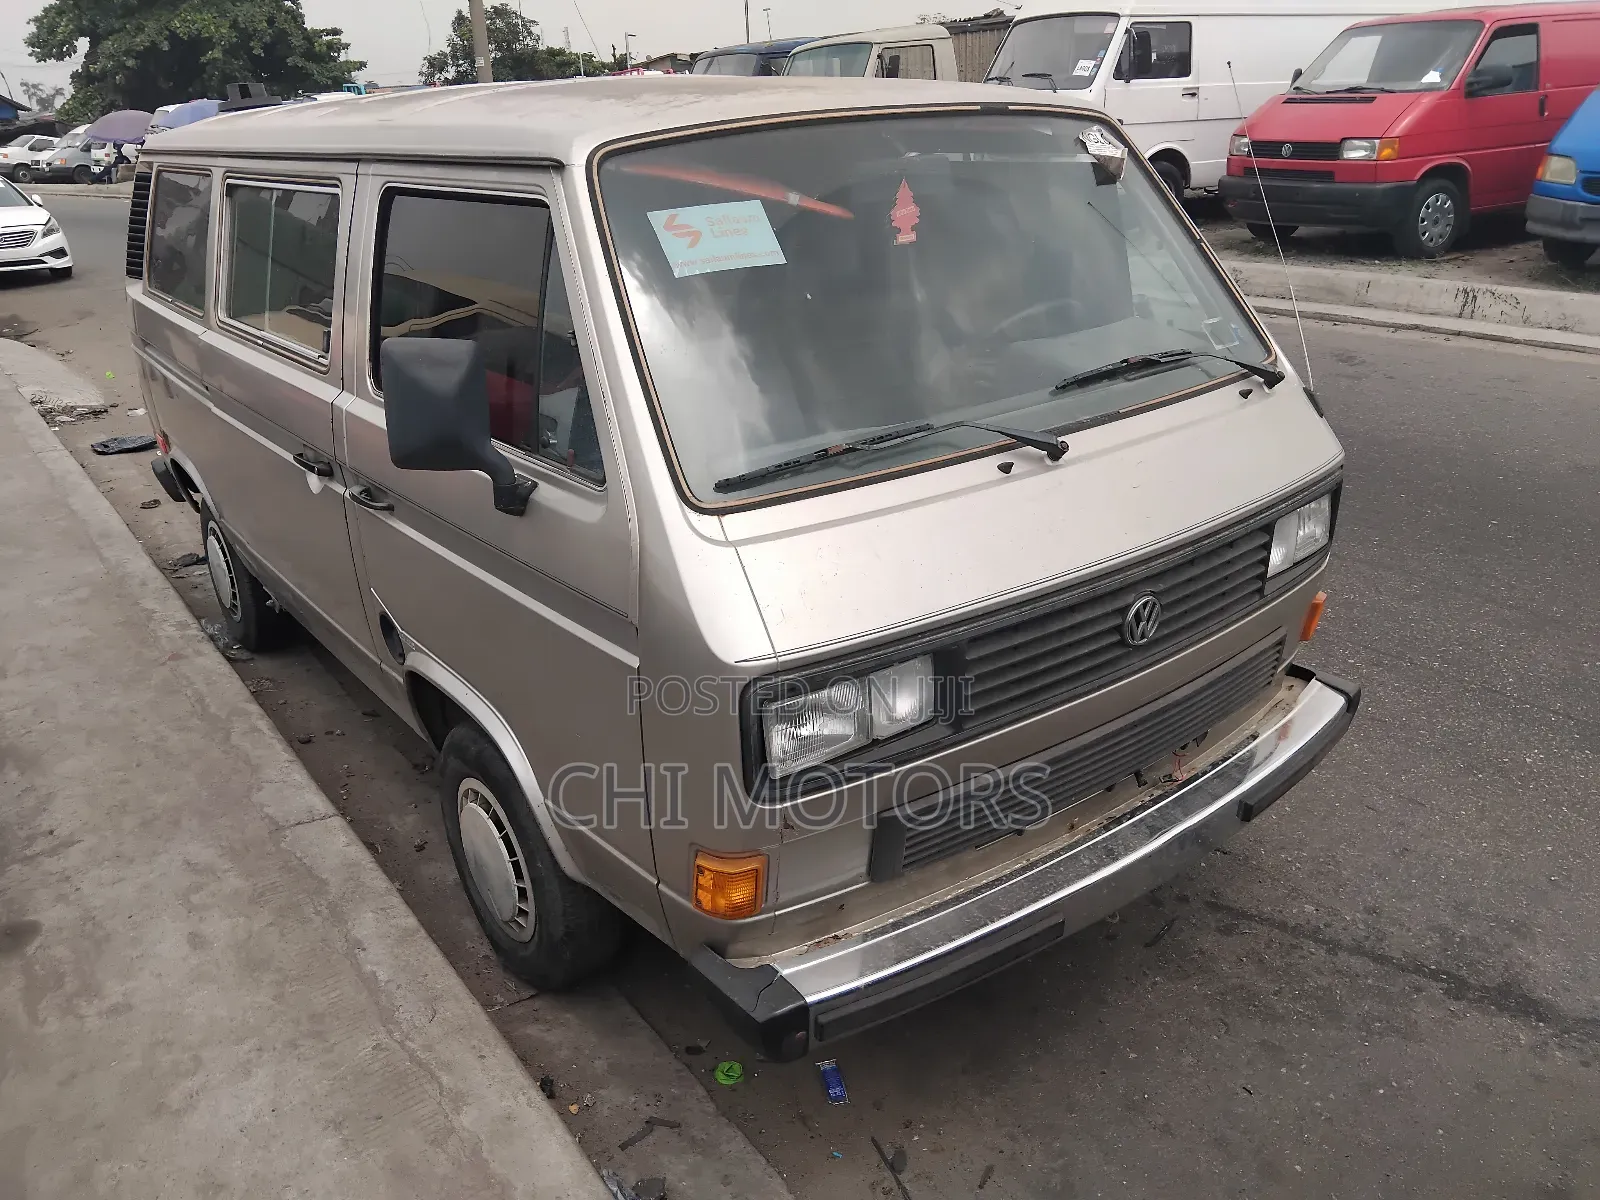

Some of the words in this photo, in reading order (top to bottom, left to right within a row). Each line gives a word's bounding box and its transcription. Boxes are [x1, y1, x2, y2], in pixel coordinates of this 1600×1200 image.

[704, 213, 761, 227] Sallaum
[709, 226, 749, 239] Lines
[1125, 596, 1161, 645] VW
